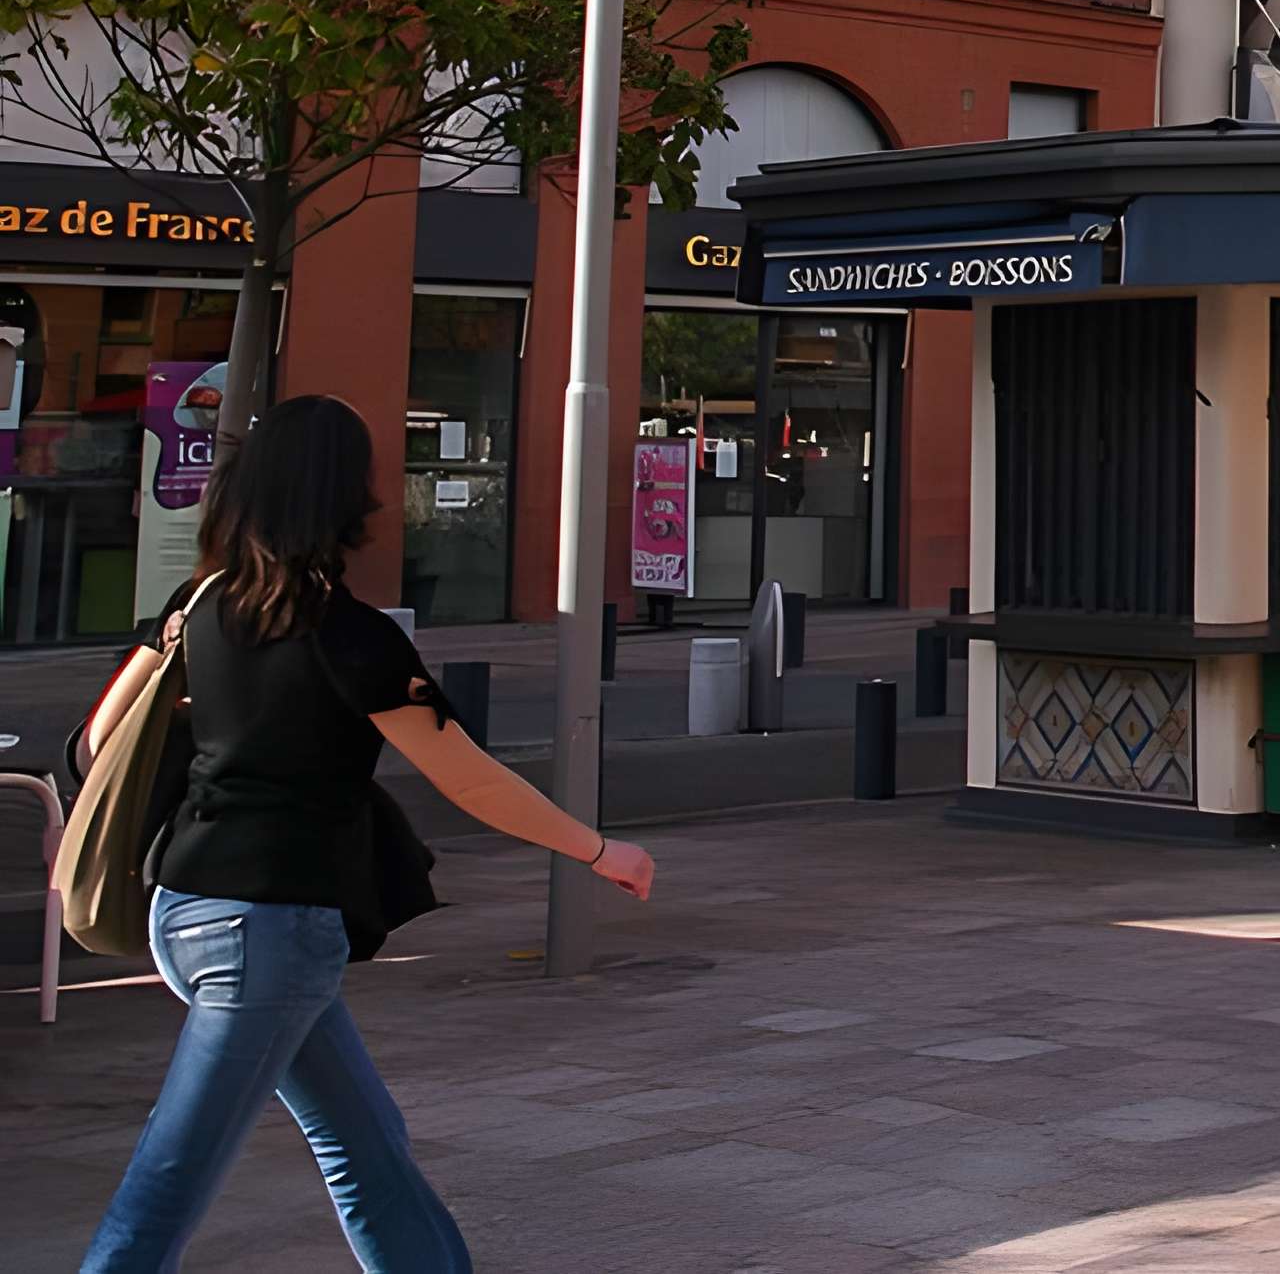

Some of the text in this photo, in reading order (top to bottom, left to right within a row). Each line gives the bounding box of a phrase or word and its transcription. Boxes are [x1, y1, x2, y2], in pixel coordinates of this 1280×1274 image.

[0, 205, 49, 233] az
[60, 200, 114, 236] de
[786, 255, 1073, 293] SANDWICHES BOISSONS
[178, 433, 213, 464] ici
